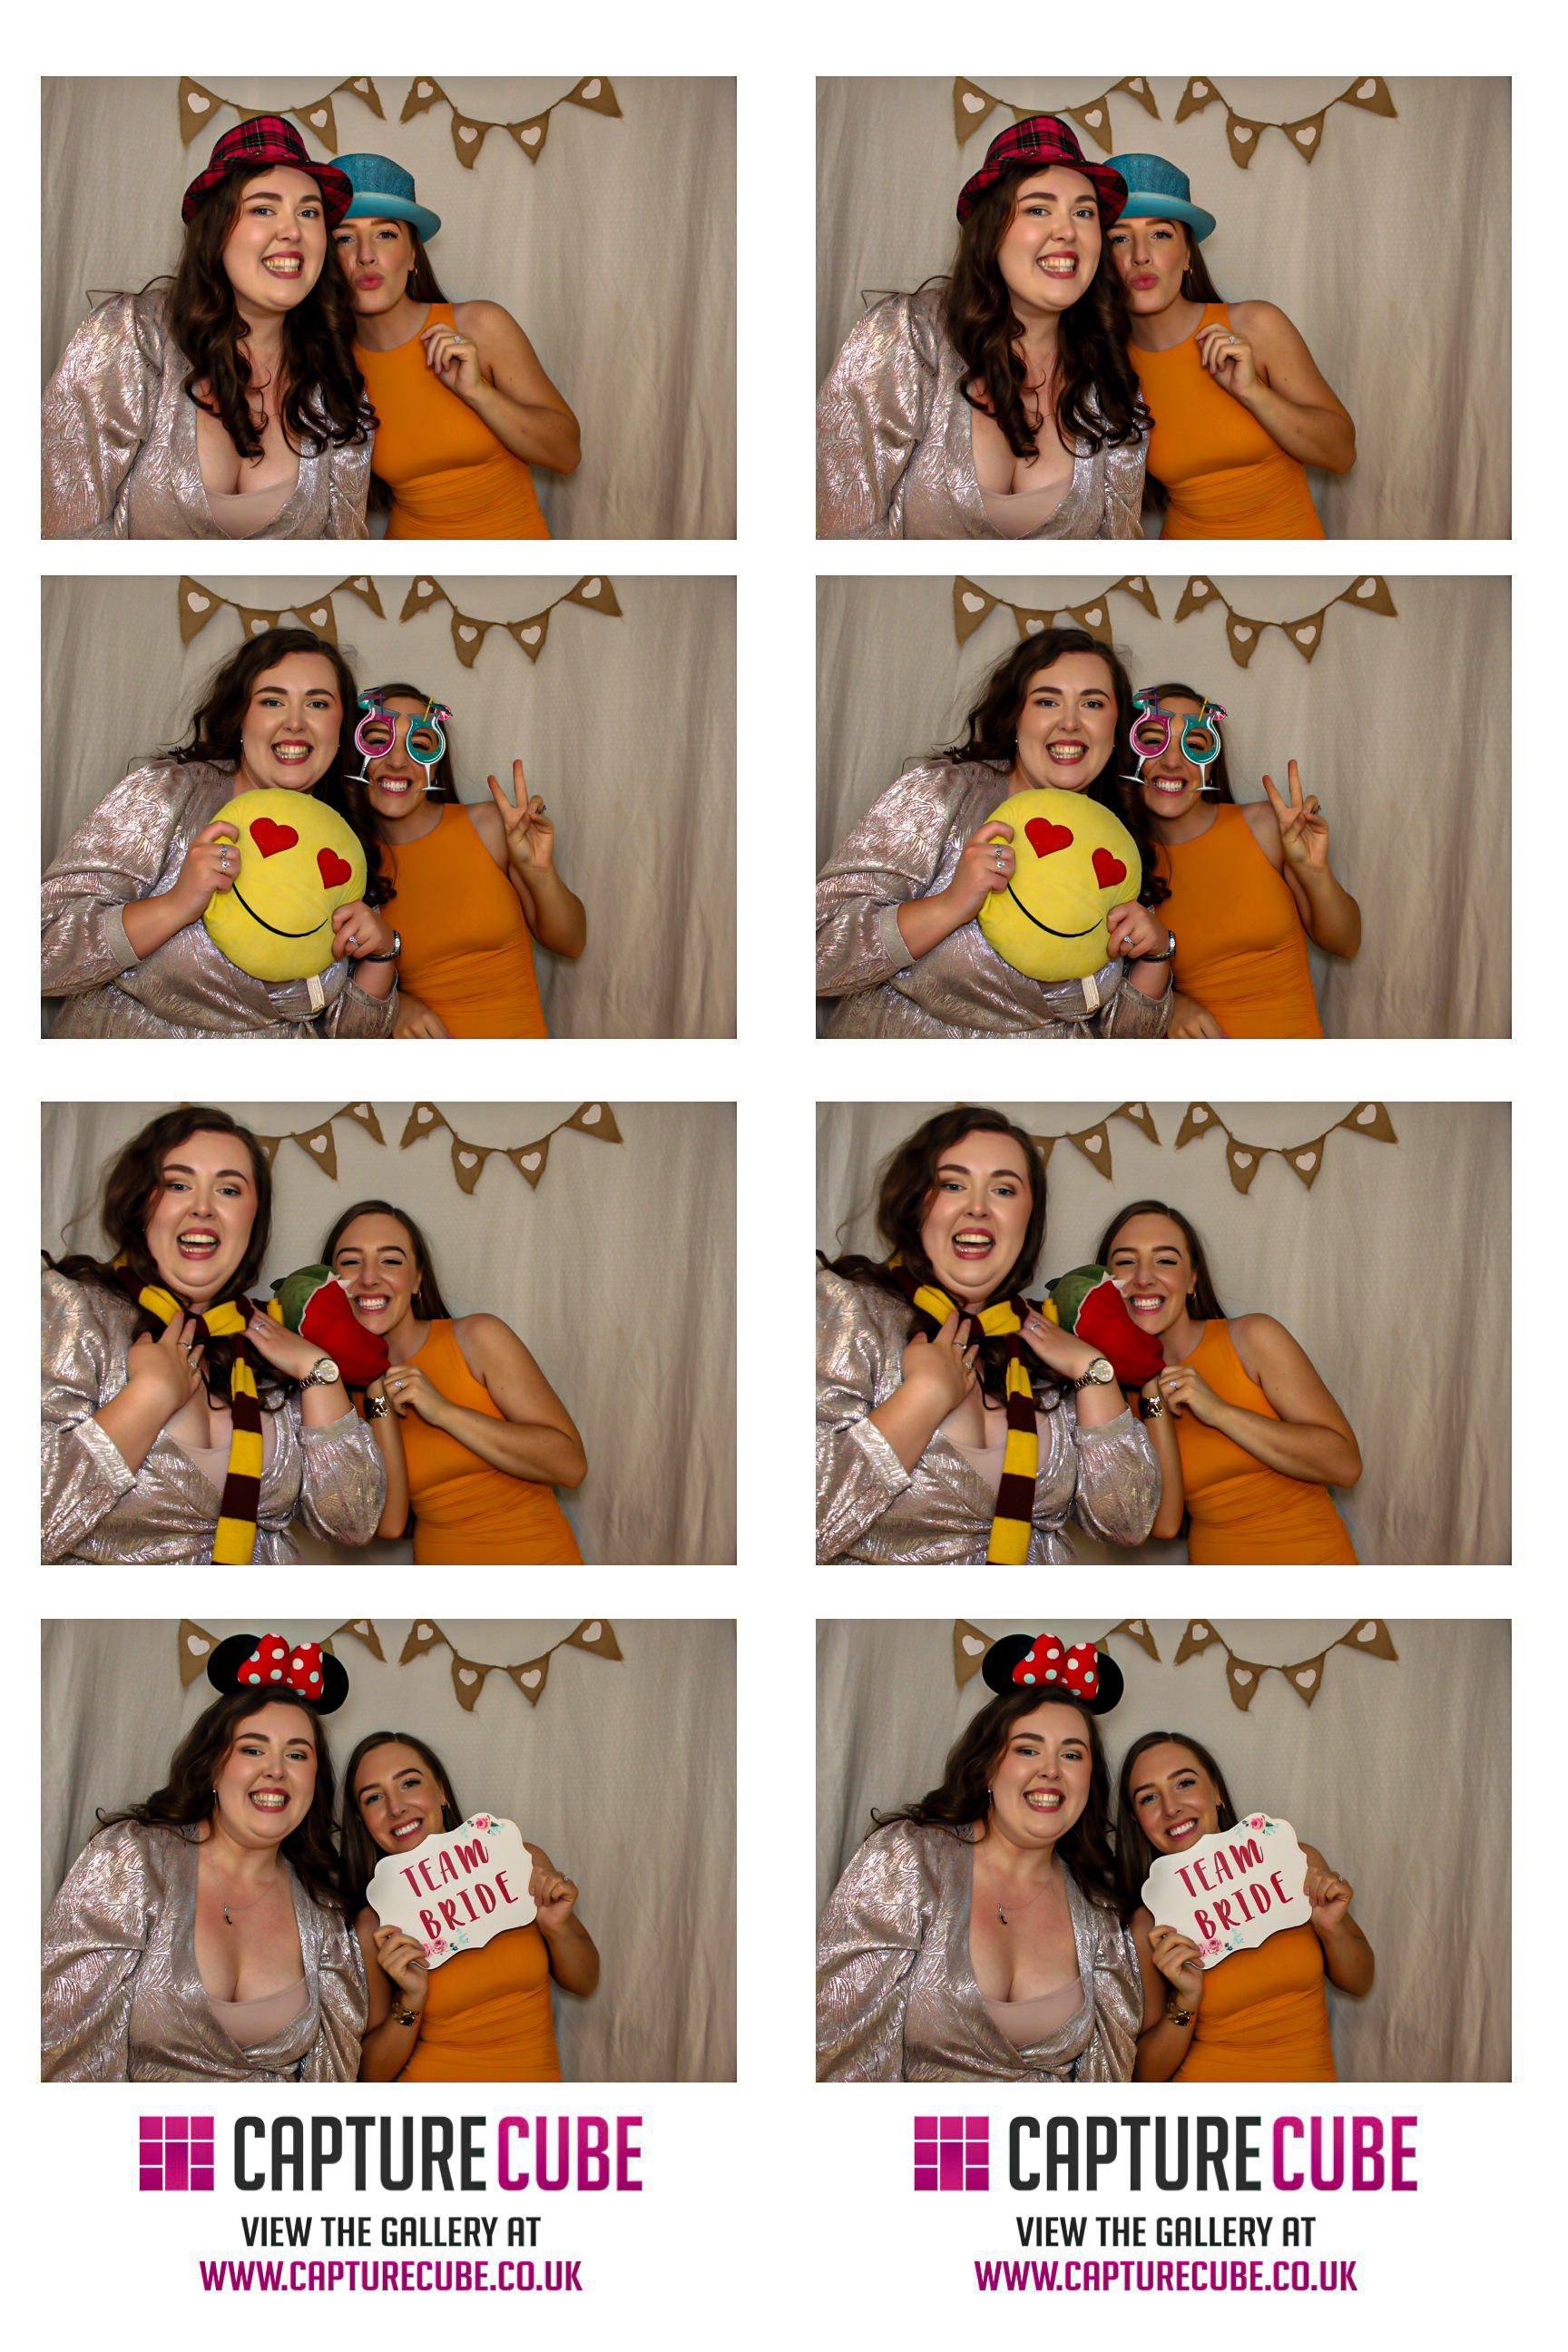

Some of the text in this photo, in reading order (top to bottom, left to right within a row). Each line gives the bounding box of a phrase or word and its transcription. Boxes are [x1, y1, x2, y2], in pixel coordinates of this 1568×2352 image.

[399, 1838, 489, 1897] TEAM
[1174, 1838, 1264, 1897] TEAM
[419, 1870, 519, 1940] BRIDE
[1194, 1870, 1294, 1940] BRIDE
